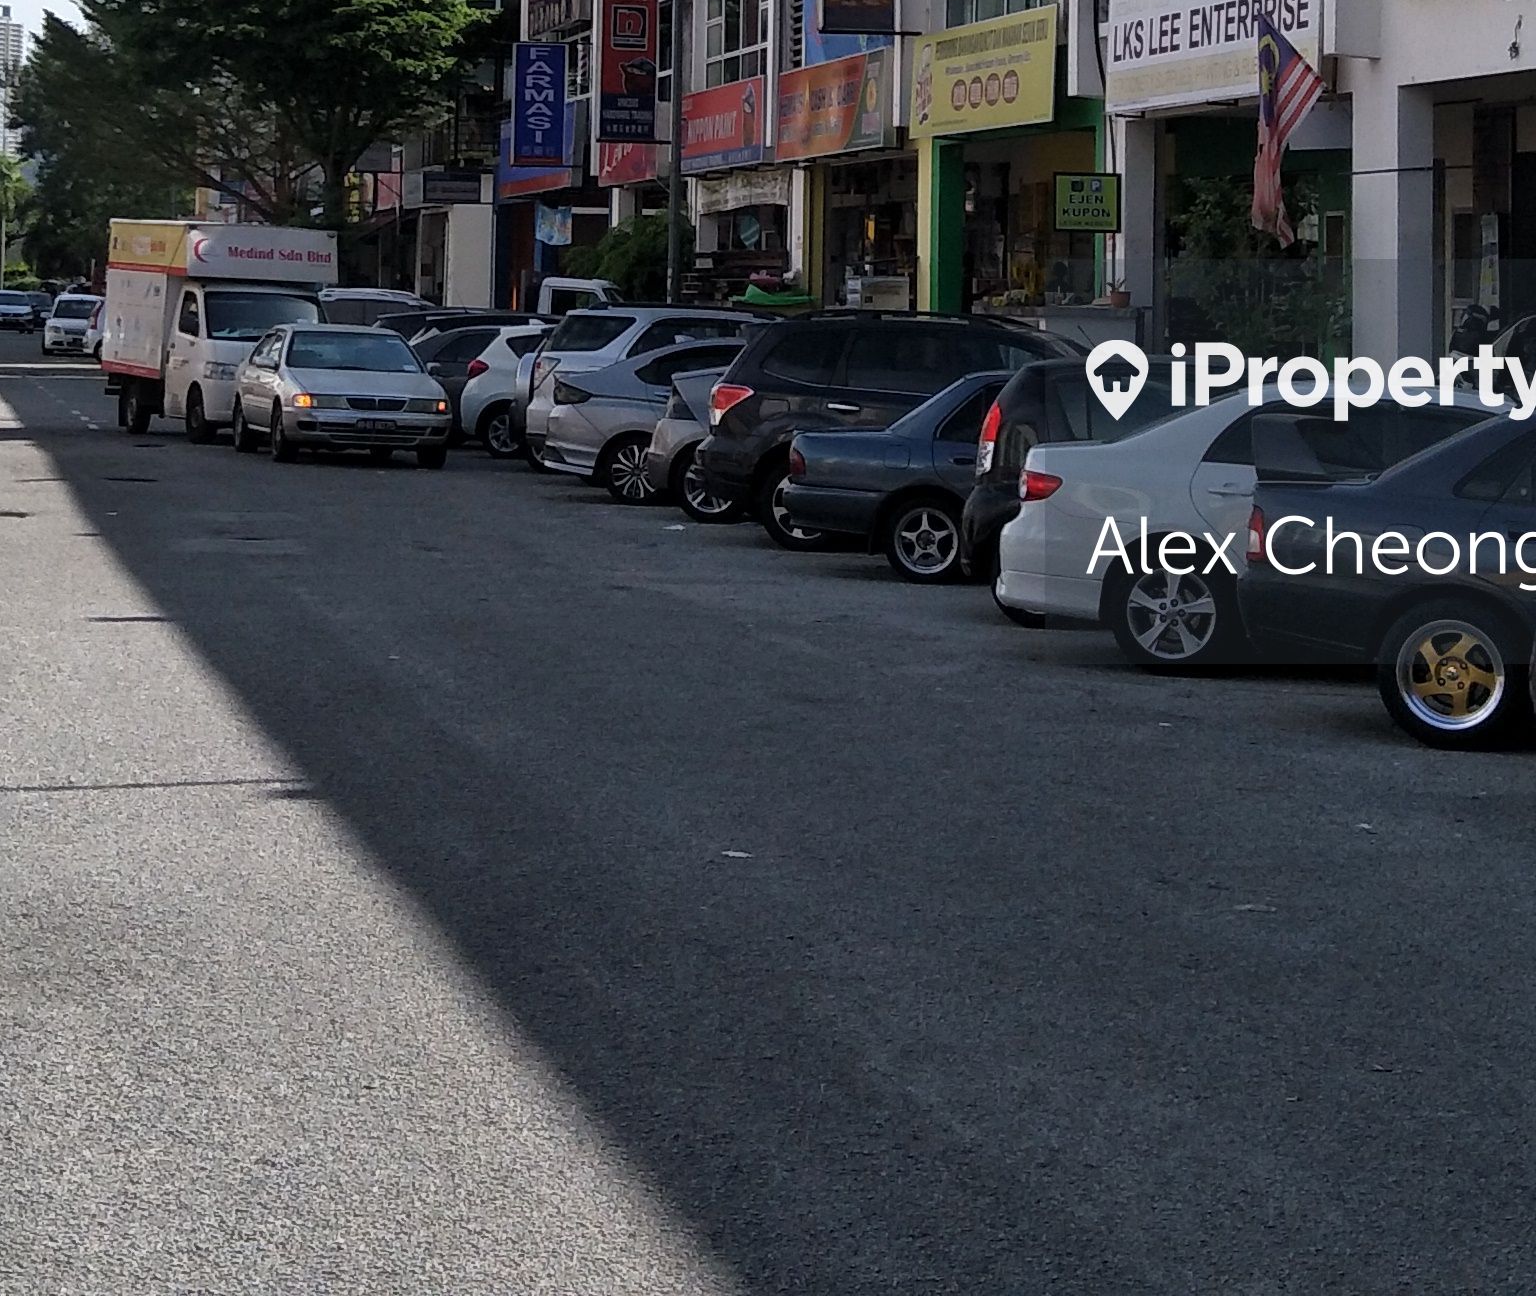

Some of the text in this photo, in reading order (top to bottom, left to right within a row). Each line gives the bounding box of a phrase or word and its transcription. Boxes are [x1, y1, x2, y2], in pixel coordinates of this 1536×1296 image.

[1114, 19, 1144, 62] LKS
[1149, 12, 1181, 56] LEE
[525, 47, 554, 143] FARMASI
[1069, 194, 1104, 204] EJEN
[1062, 208, 1111, 217] KUPON
[228, 246, 331, 263] Medind Sdn Bhd
